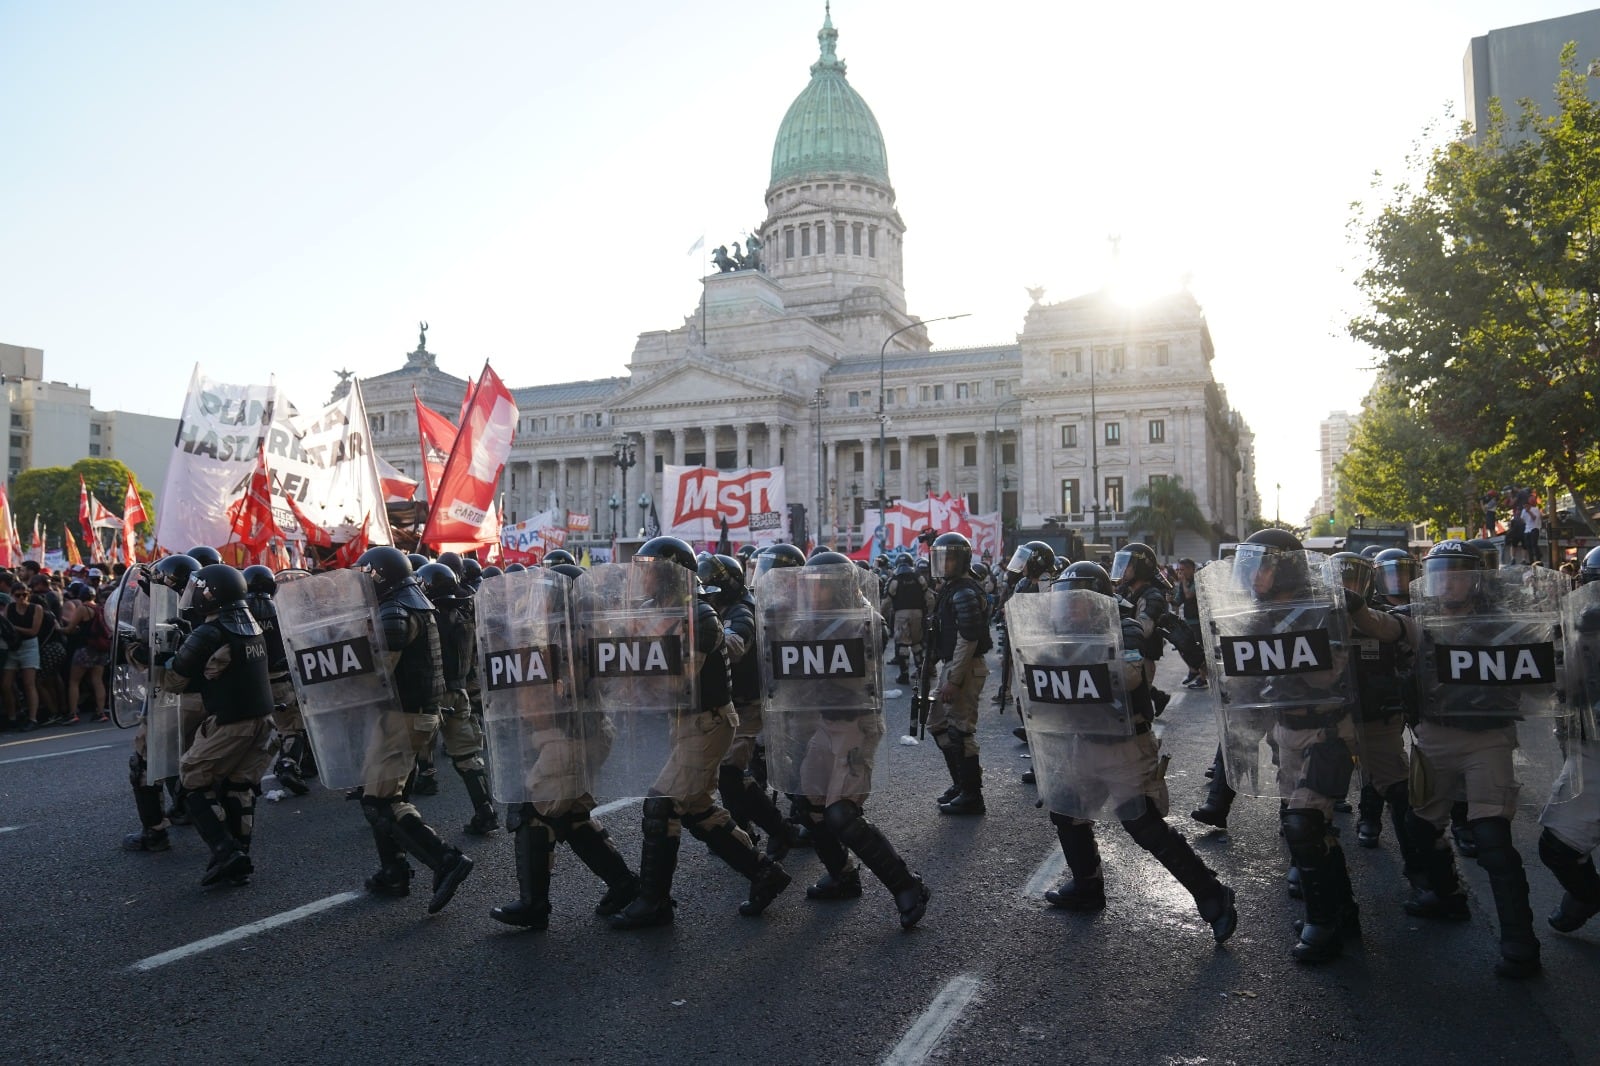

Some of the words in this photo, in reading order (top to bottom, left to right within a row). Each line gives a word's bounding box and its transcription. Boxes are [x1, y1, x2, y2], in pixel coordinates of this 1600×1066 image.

[681, 473, 772, 525] MST
[1433, 542, 1462, 553] PNA
[259, 620, 274, 631] NA
[245, 643, 266, 659] PNA
[301, 644, 362, 681] PNA
[599, 641, 669, 673] PNA
[781, 644, 853, 675] PNA
[1232, 636, 1320, 672] PNA
[1450, 649, 1541, 681] PNA
[490, 651, 548, 685] PNA
[1032, 669, 1100, 700] PNA
